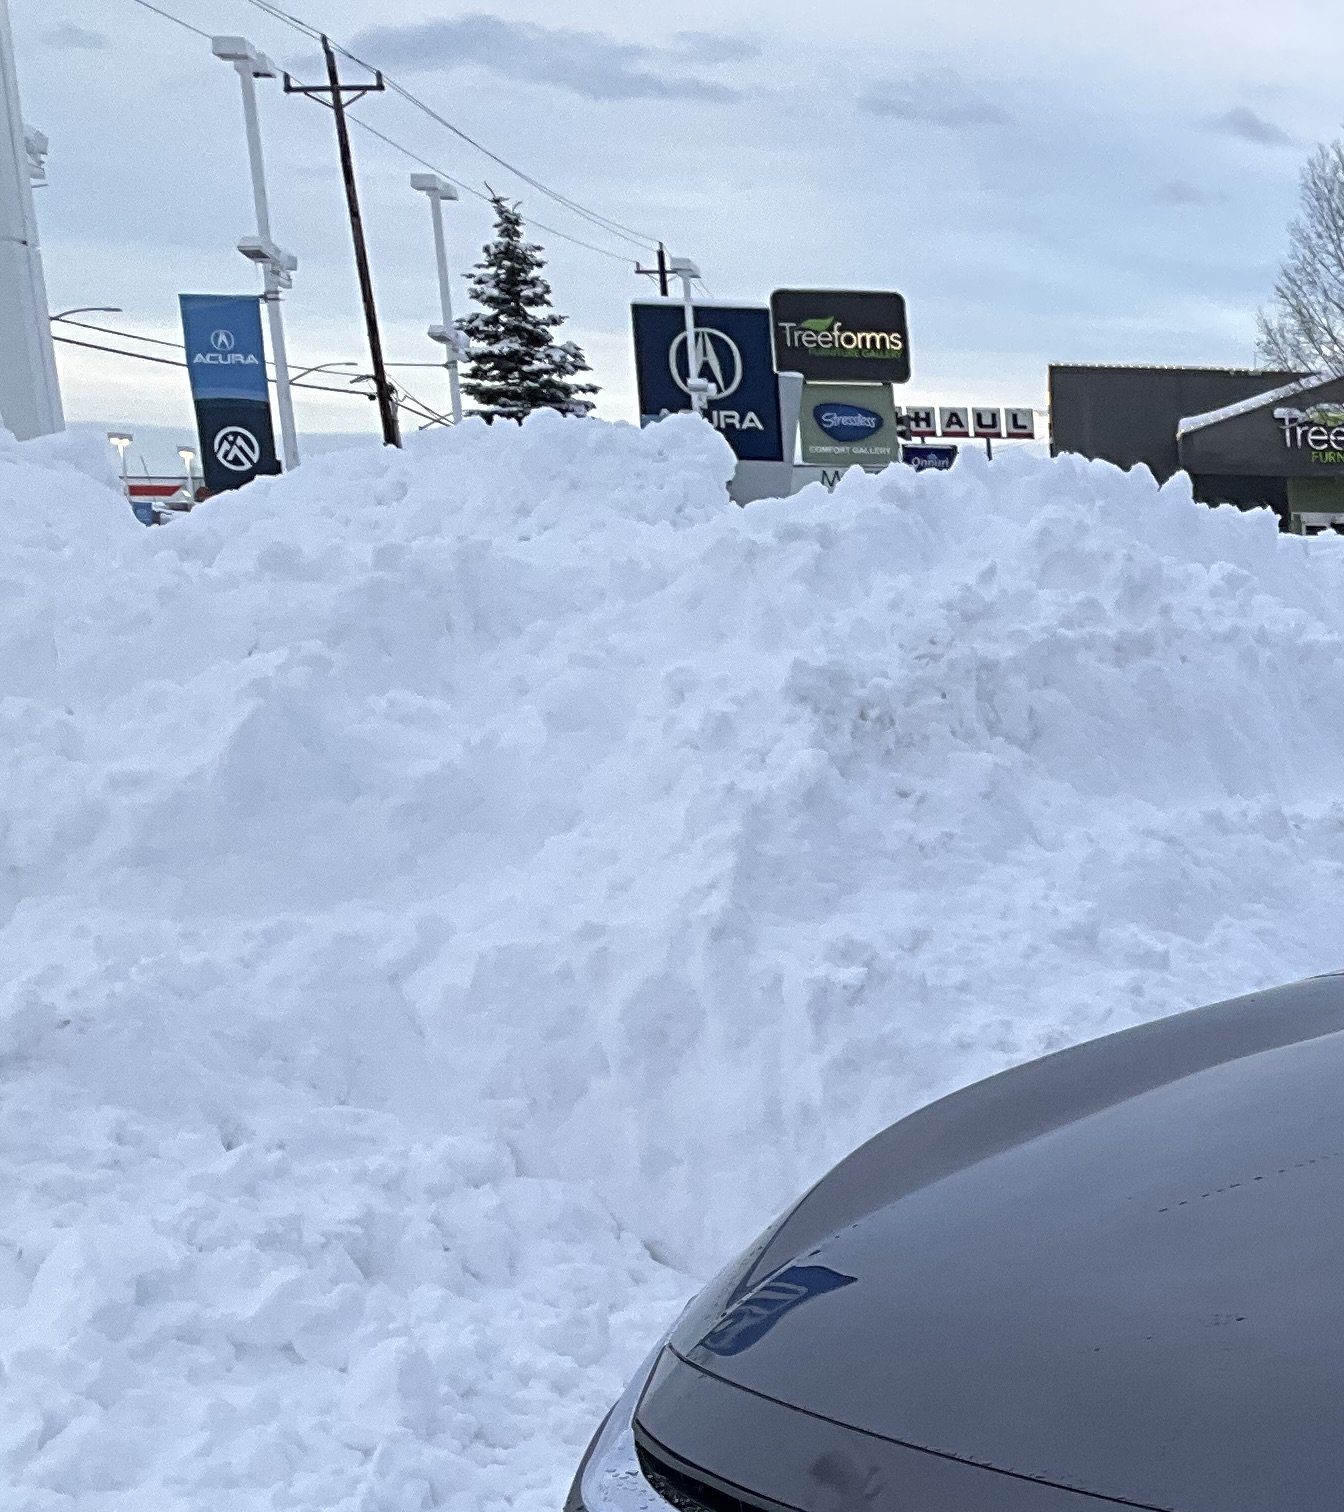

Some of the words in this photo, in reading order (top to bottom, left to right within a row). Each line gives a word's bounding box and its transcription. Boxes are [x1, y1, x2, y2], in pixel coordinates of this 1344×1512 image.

[778, 321, 903, 350] Treeforms
[193, 353, 259, 365] ACURA
[822, 412, 876, 428] Stressless
[808, 446, 850, 454] COMFORT
[852, 446, 891, 455] GALLERY
